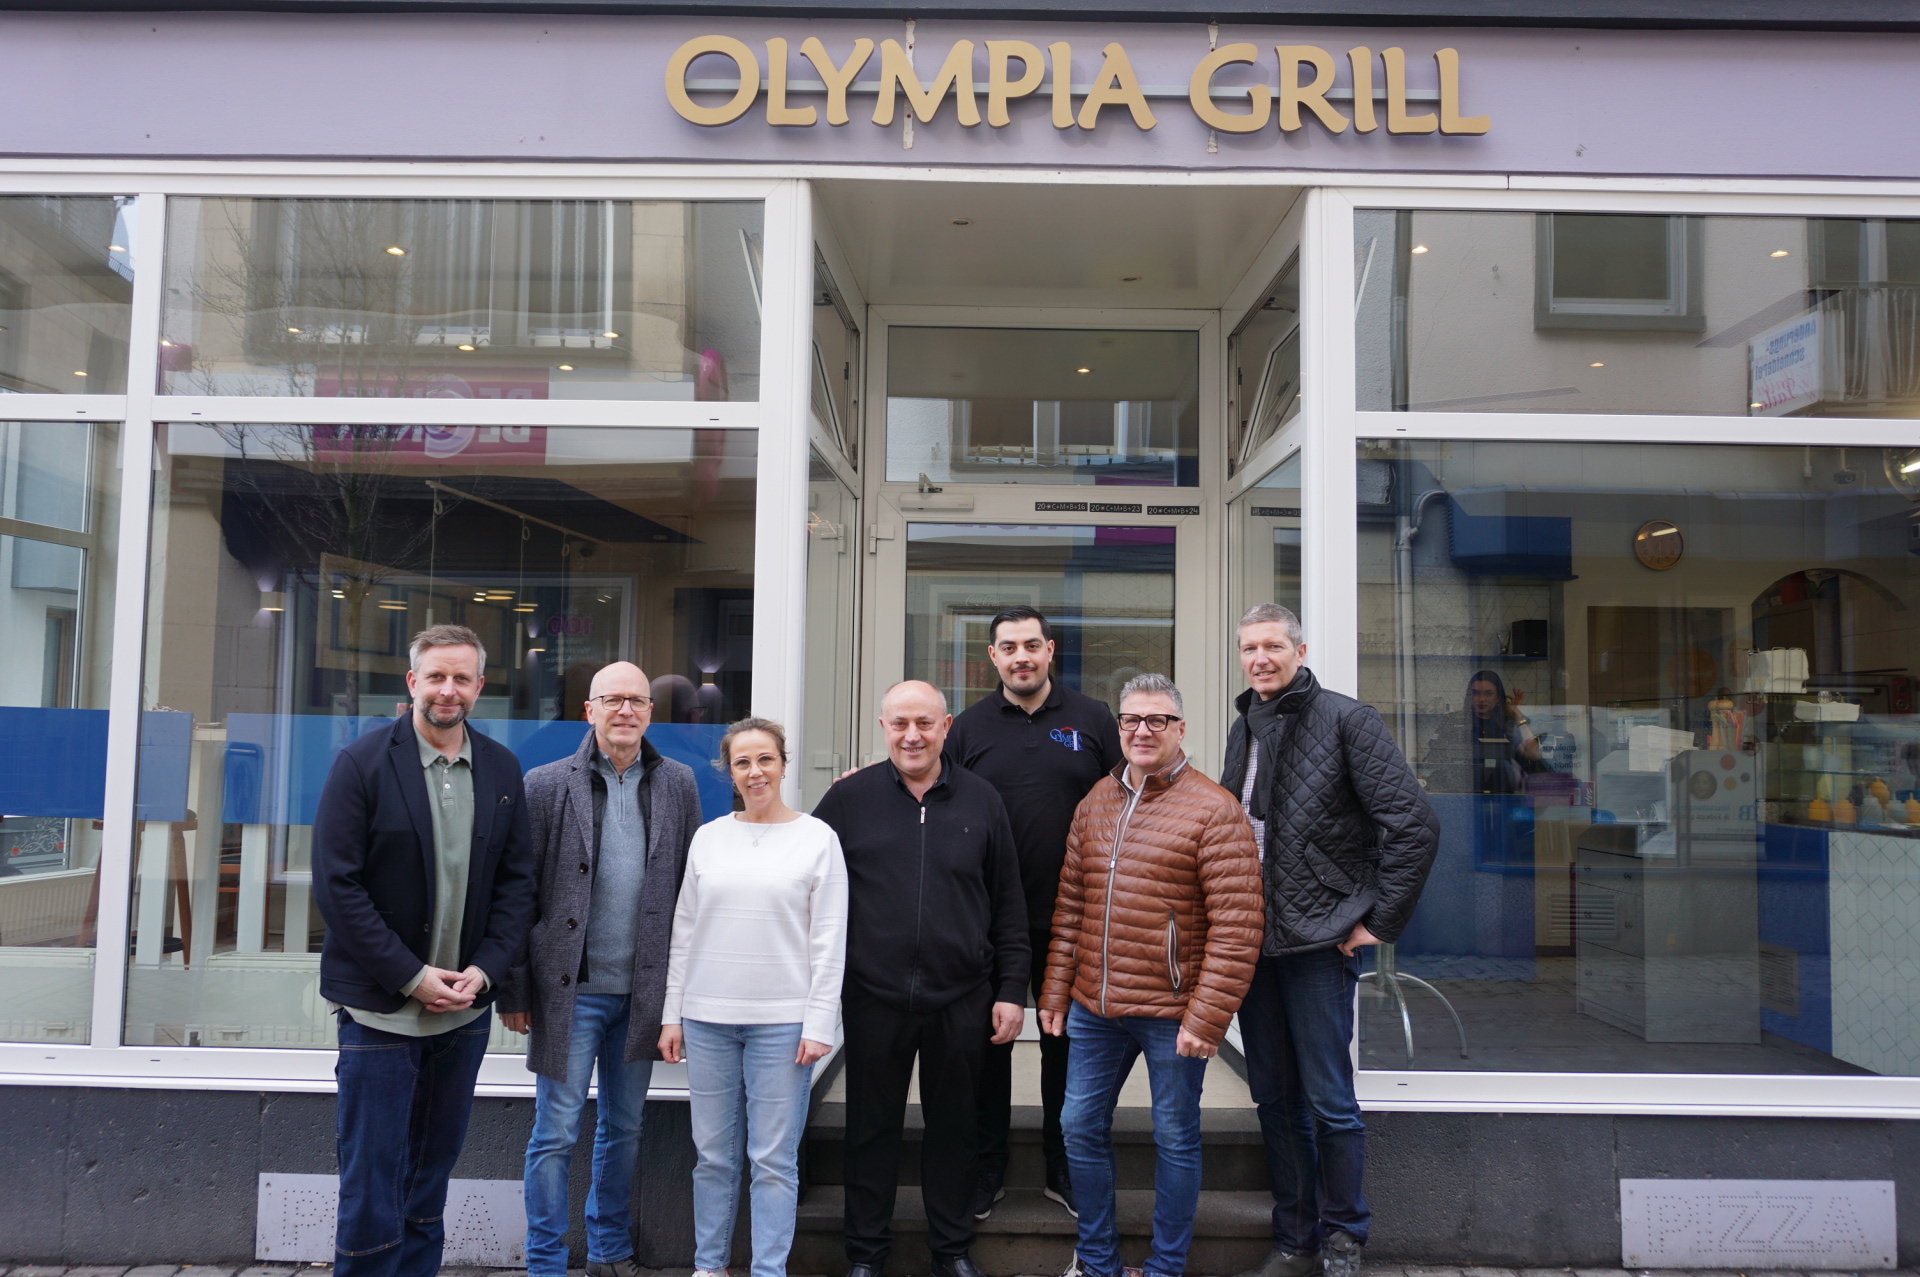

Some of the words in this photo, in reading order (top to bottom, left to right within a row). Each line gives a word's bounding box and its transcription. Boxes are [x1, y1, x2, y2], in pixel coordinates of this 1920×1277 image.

[664, 34, 1158, 131] OLYMPIA
[1188, 42, 1492, 138] GRILL
[1645, 1195, 1870, 1253] PIZZA
